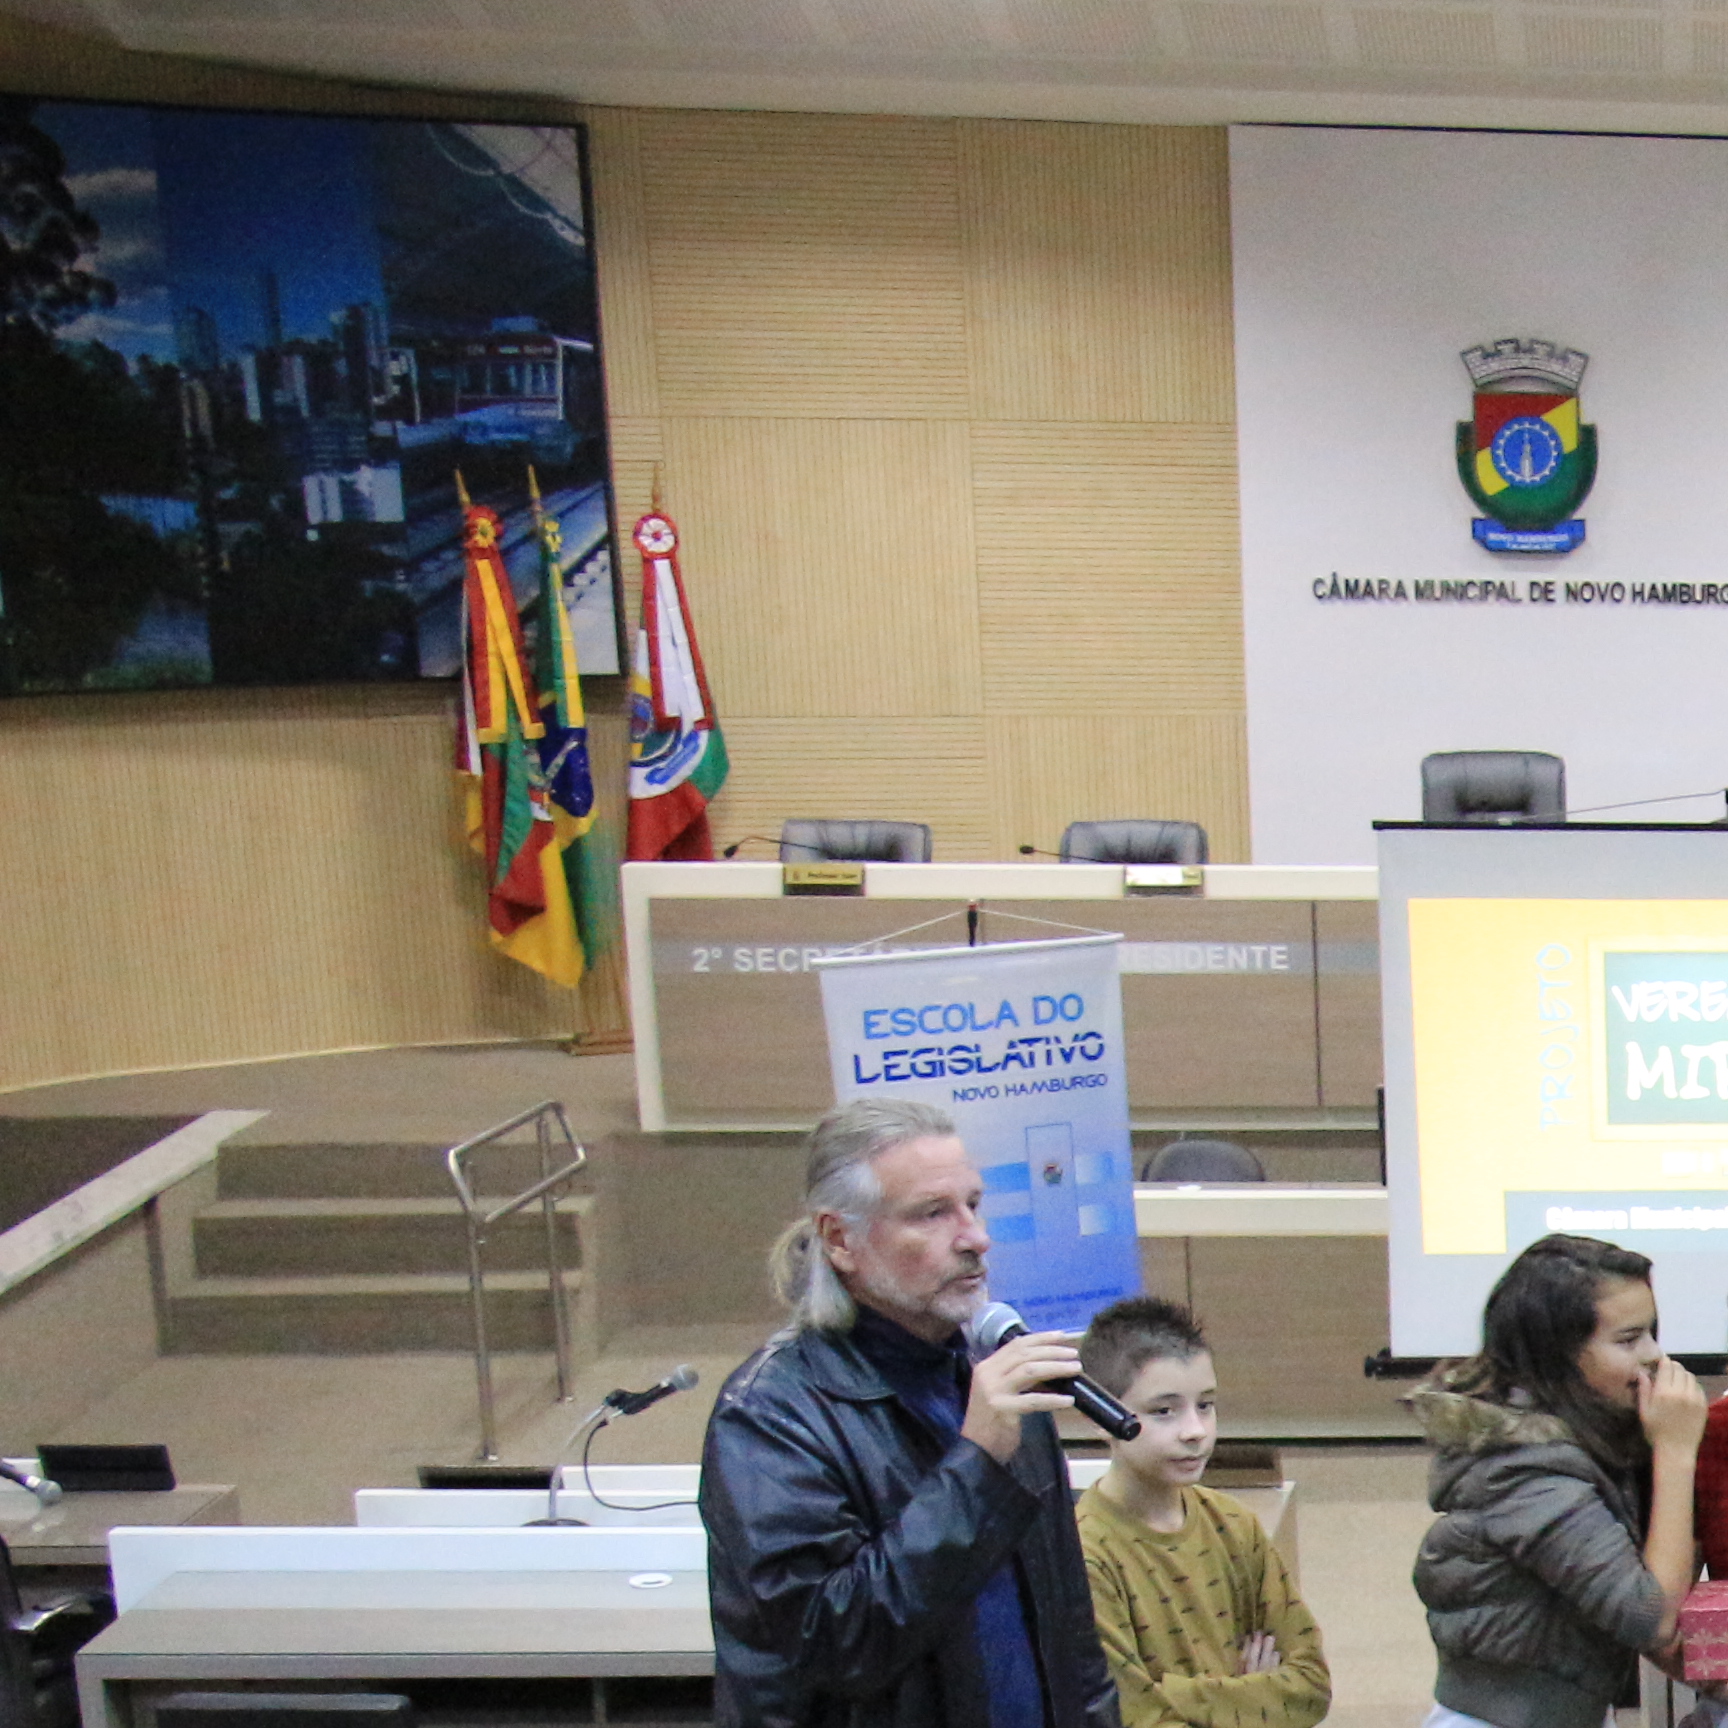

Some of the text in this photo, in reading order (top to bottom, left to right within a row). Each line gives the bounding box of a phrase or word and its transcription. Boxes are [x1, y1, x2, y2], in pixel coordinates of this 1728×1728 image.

[1311, 571, 1409, 601] CÂMARA
[1413, 578, 1524, 604] MUNICIPAL
[1528, 580, 1557, 603] DE
[1564, 580, 1626, 604] NOVO
[863, 993, 1085, 1040] ESCOLA DO
[1535, 943, 1581, 1132] PROJETO
[853, 1031, 1106, 1085] LEGISLATIVO
[952, 1073, 1109, 1103] NOVO HAMBURGO
